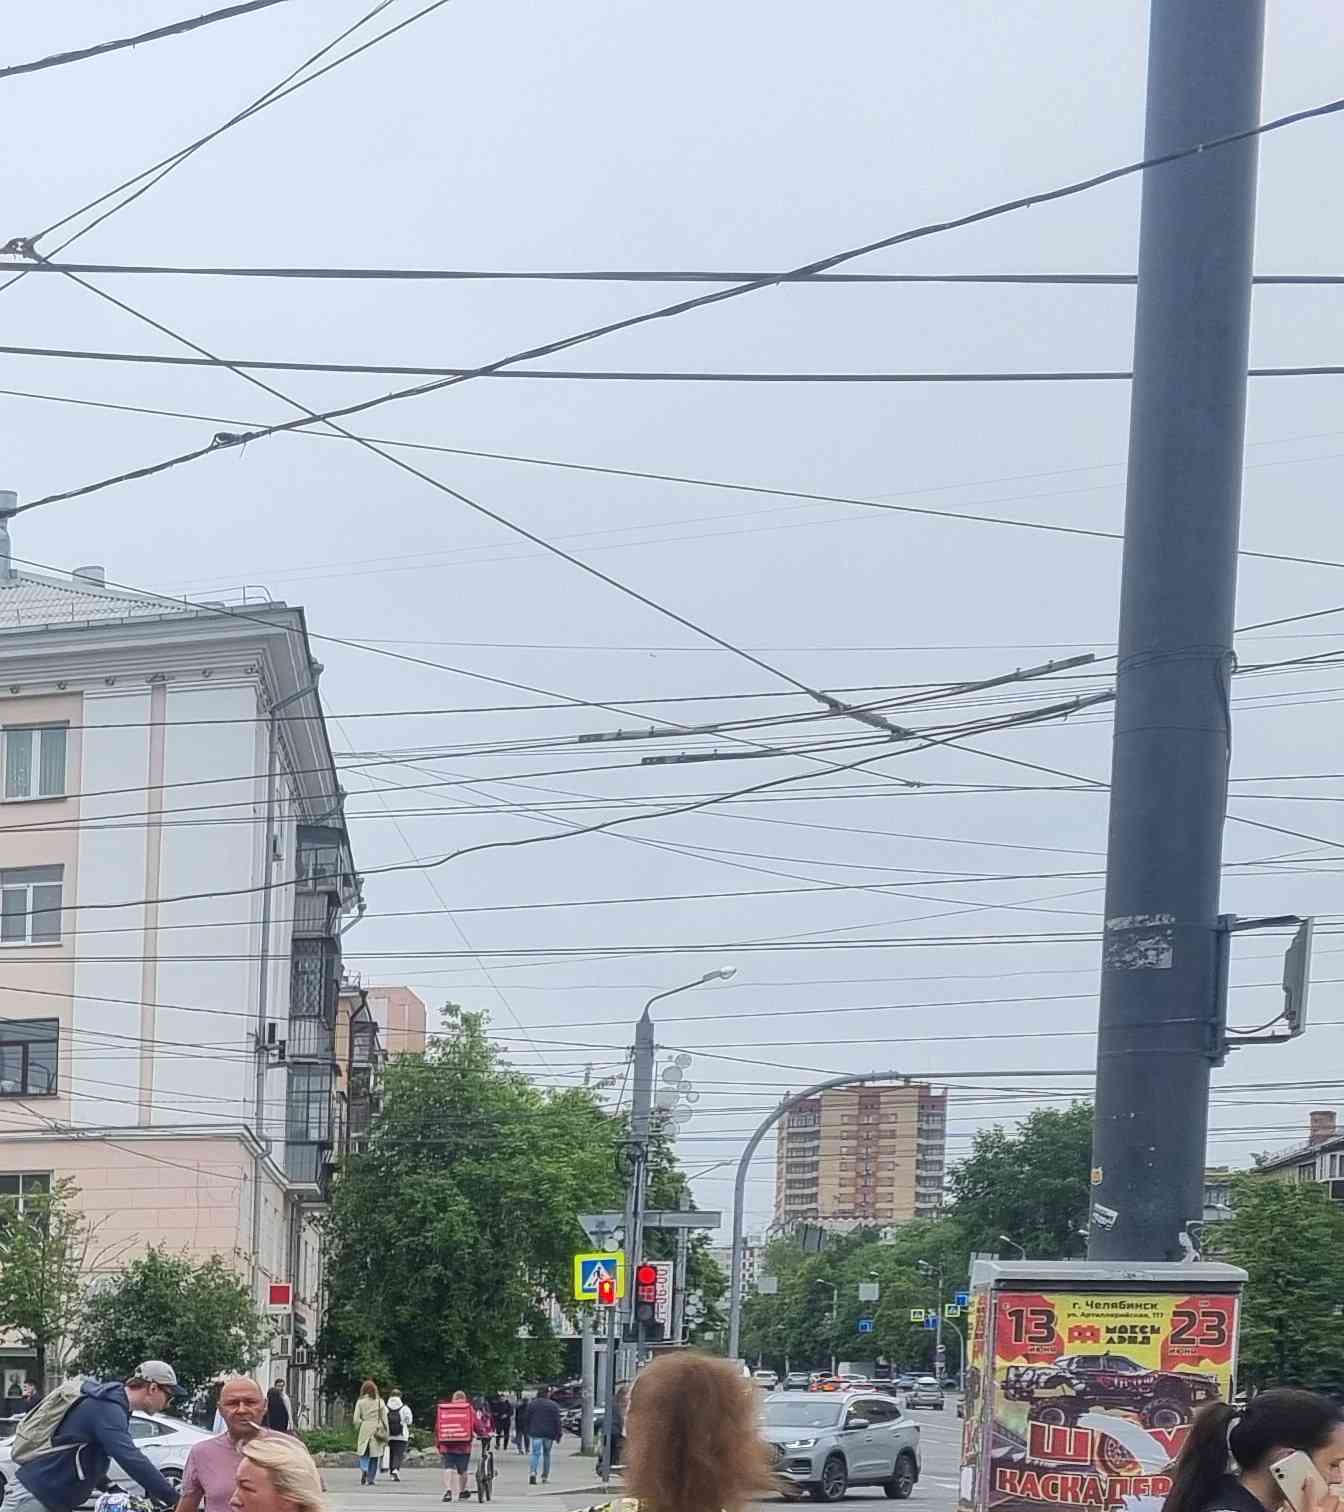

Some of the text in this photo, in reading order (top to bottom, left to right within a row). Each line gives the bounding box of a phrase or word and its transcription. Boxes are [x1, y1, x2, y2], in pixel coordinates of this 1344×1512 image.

[1072, 1300, 1159, 1311] г. Челябинск
[1007, 1307, 1057, 1346] 13
[1170, 1308, 1229, 1347] 23
